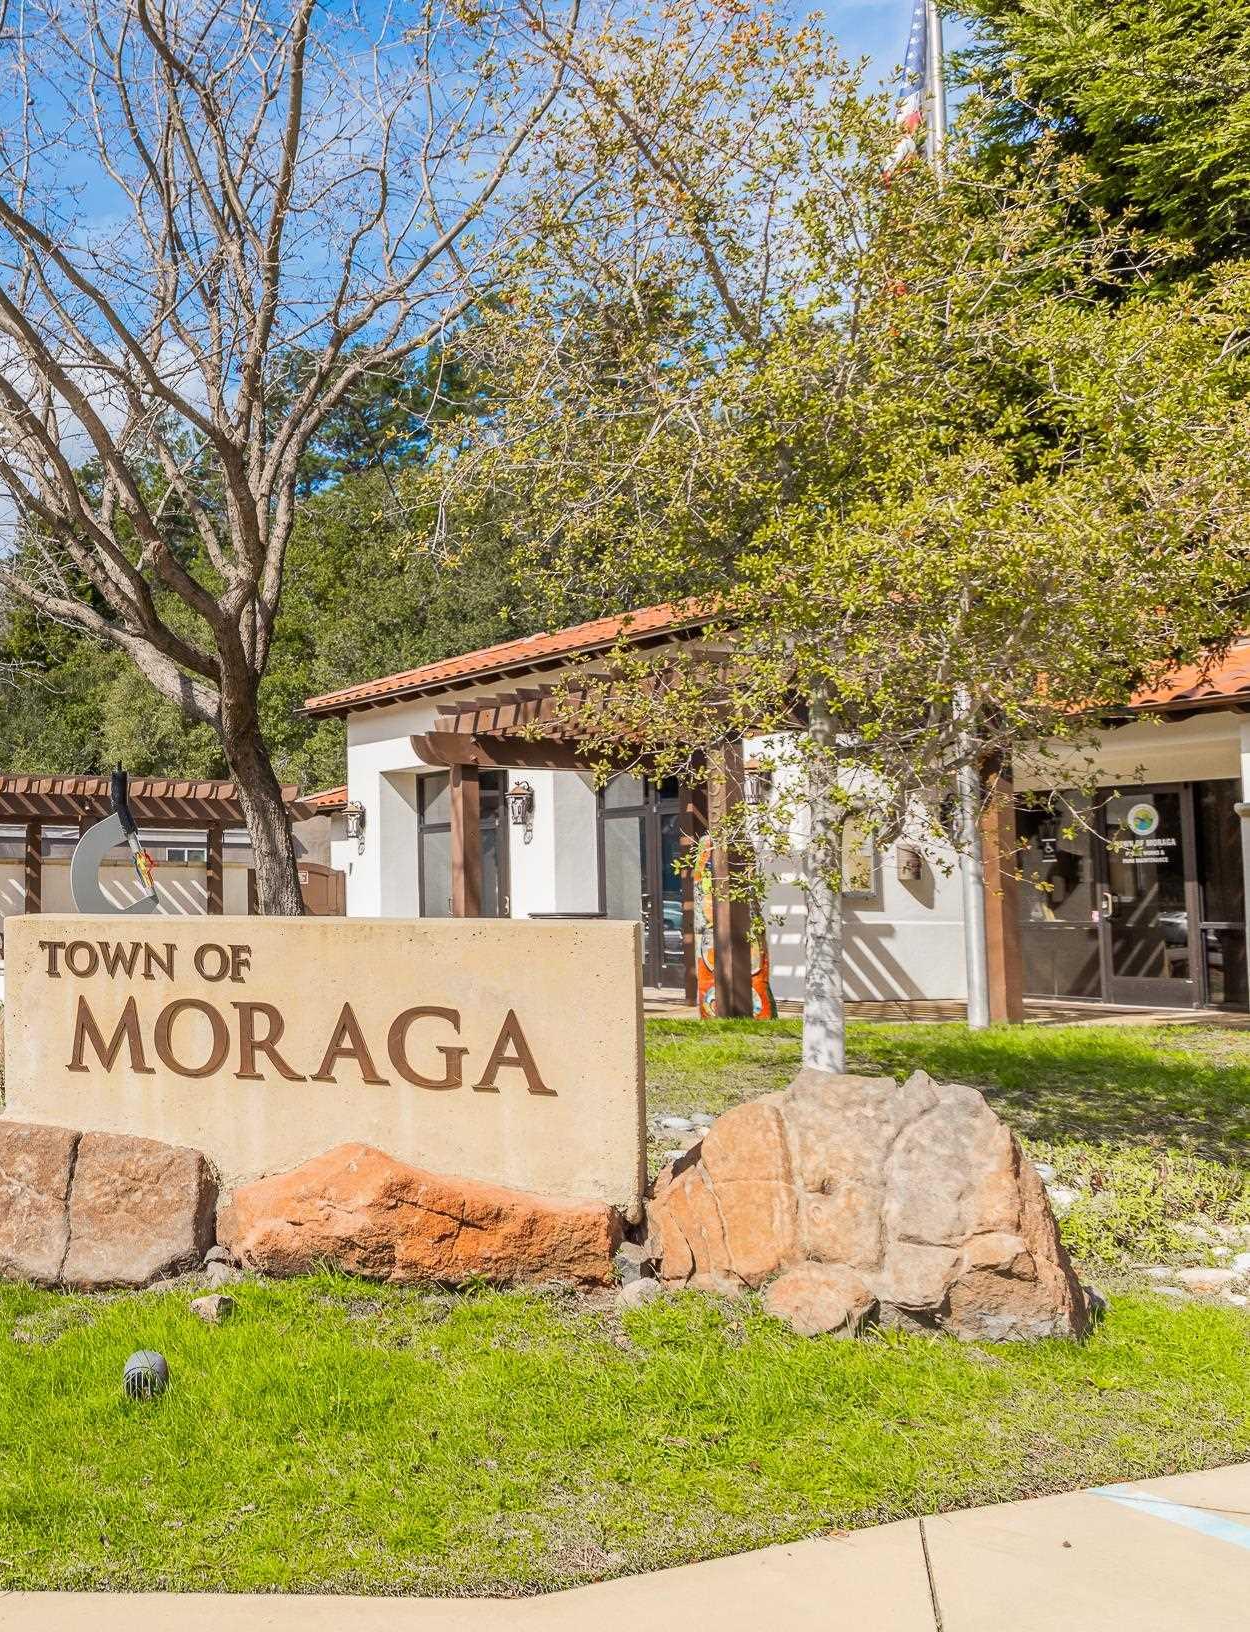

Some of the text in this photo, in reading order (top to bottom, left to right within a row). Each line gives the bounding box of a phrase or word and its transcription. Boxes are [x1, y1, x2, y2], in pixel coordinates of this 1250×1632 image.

[38, 940, 252, 983] TOWN OF
[66, 995, 558, 1097] MORAGA
